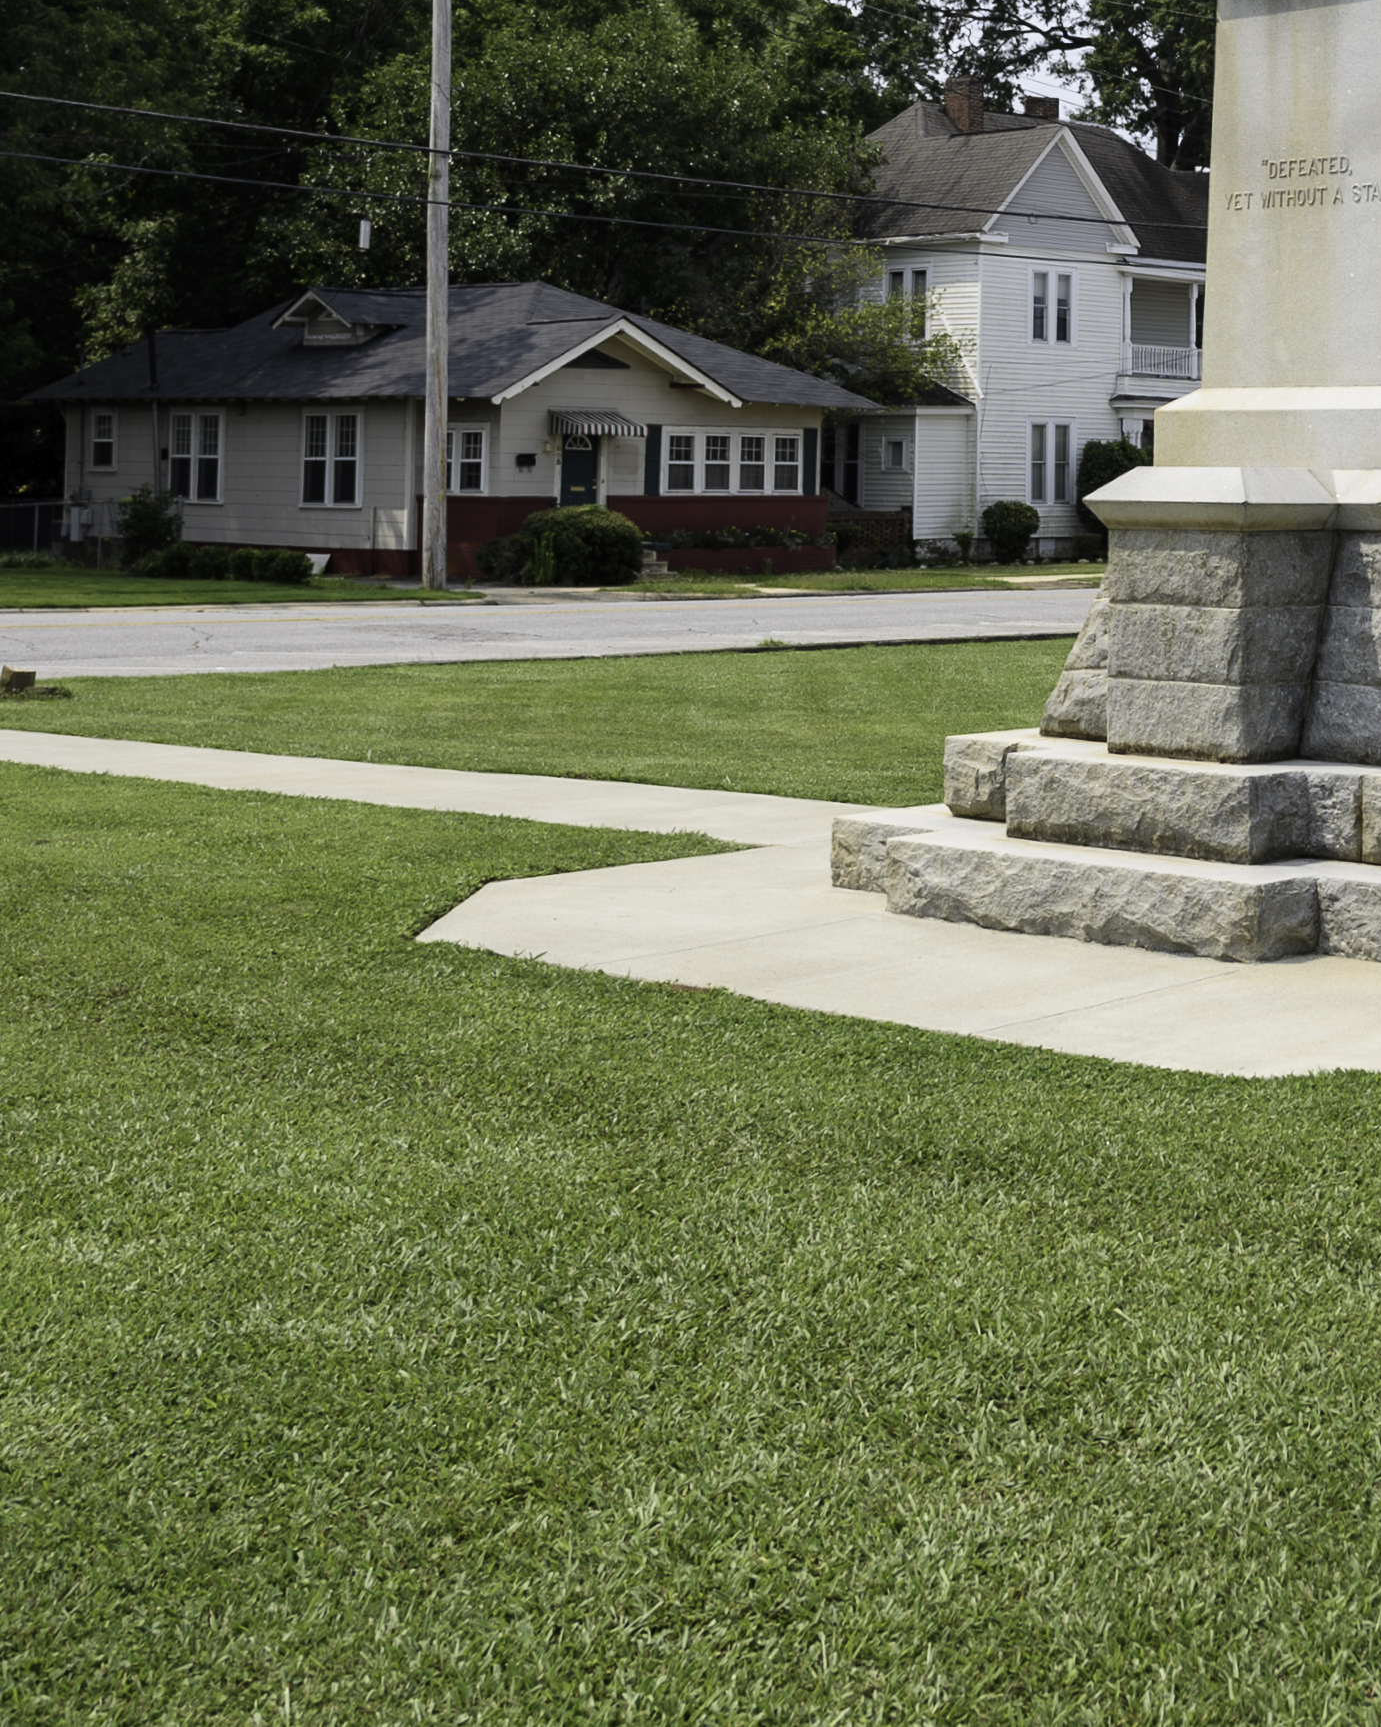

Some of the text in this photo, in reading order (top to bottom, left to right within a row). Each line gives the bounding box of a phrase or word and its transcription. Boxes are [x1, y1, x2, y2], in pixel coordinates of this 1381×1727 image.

[1225, 191, 1254, 211] YET
[1261, 186, 1328, 209] WITHOUT
[1332, 186, 1344, 205] A
